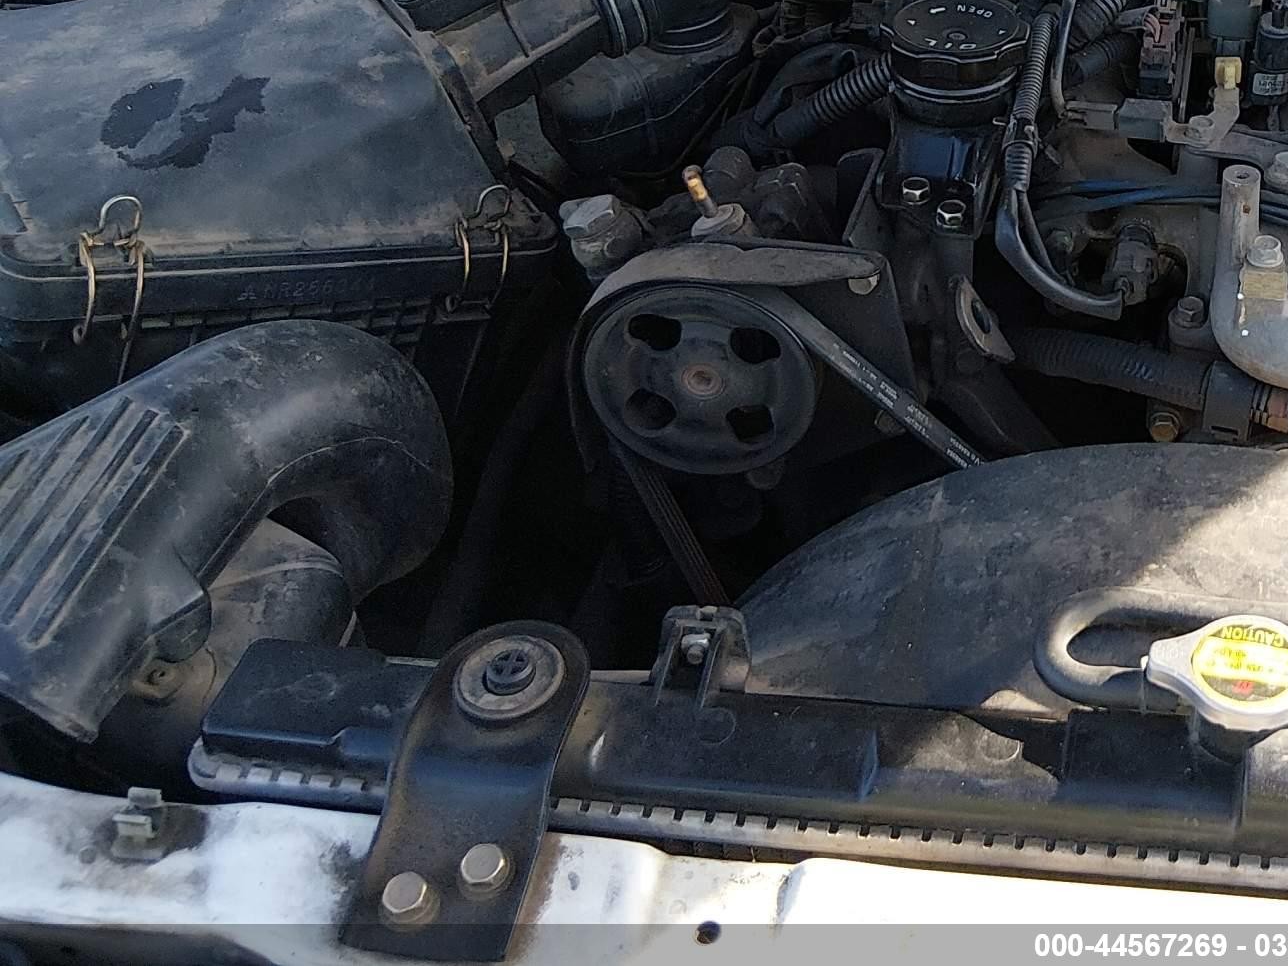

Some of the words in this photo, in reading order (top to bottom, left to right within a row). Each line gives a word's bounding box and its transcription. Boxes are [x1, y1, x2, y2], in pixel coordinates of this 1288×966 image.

[956, 4, 993, 18] OPEN
[924, 37, 977, 50] OIL
[1221, 625, 1286, 647] CAUTION
